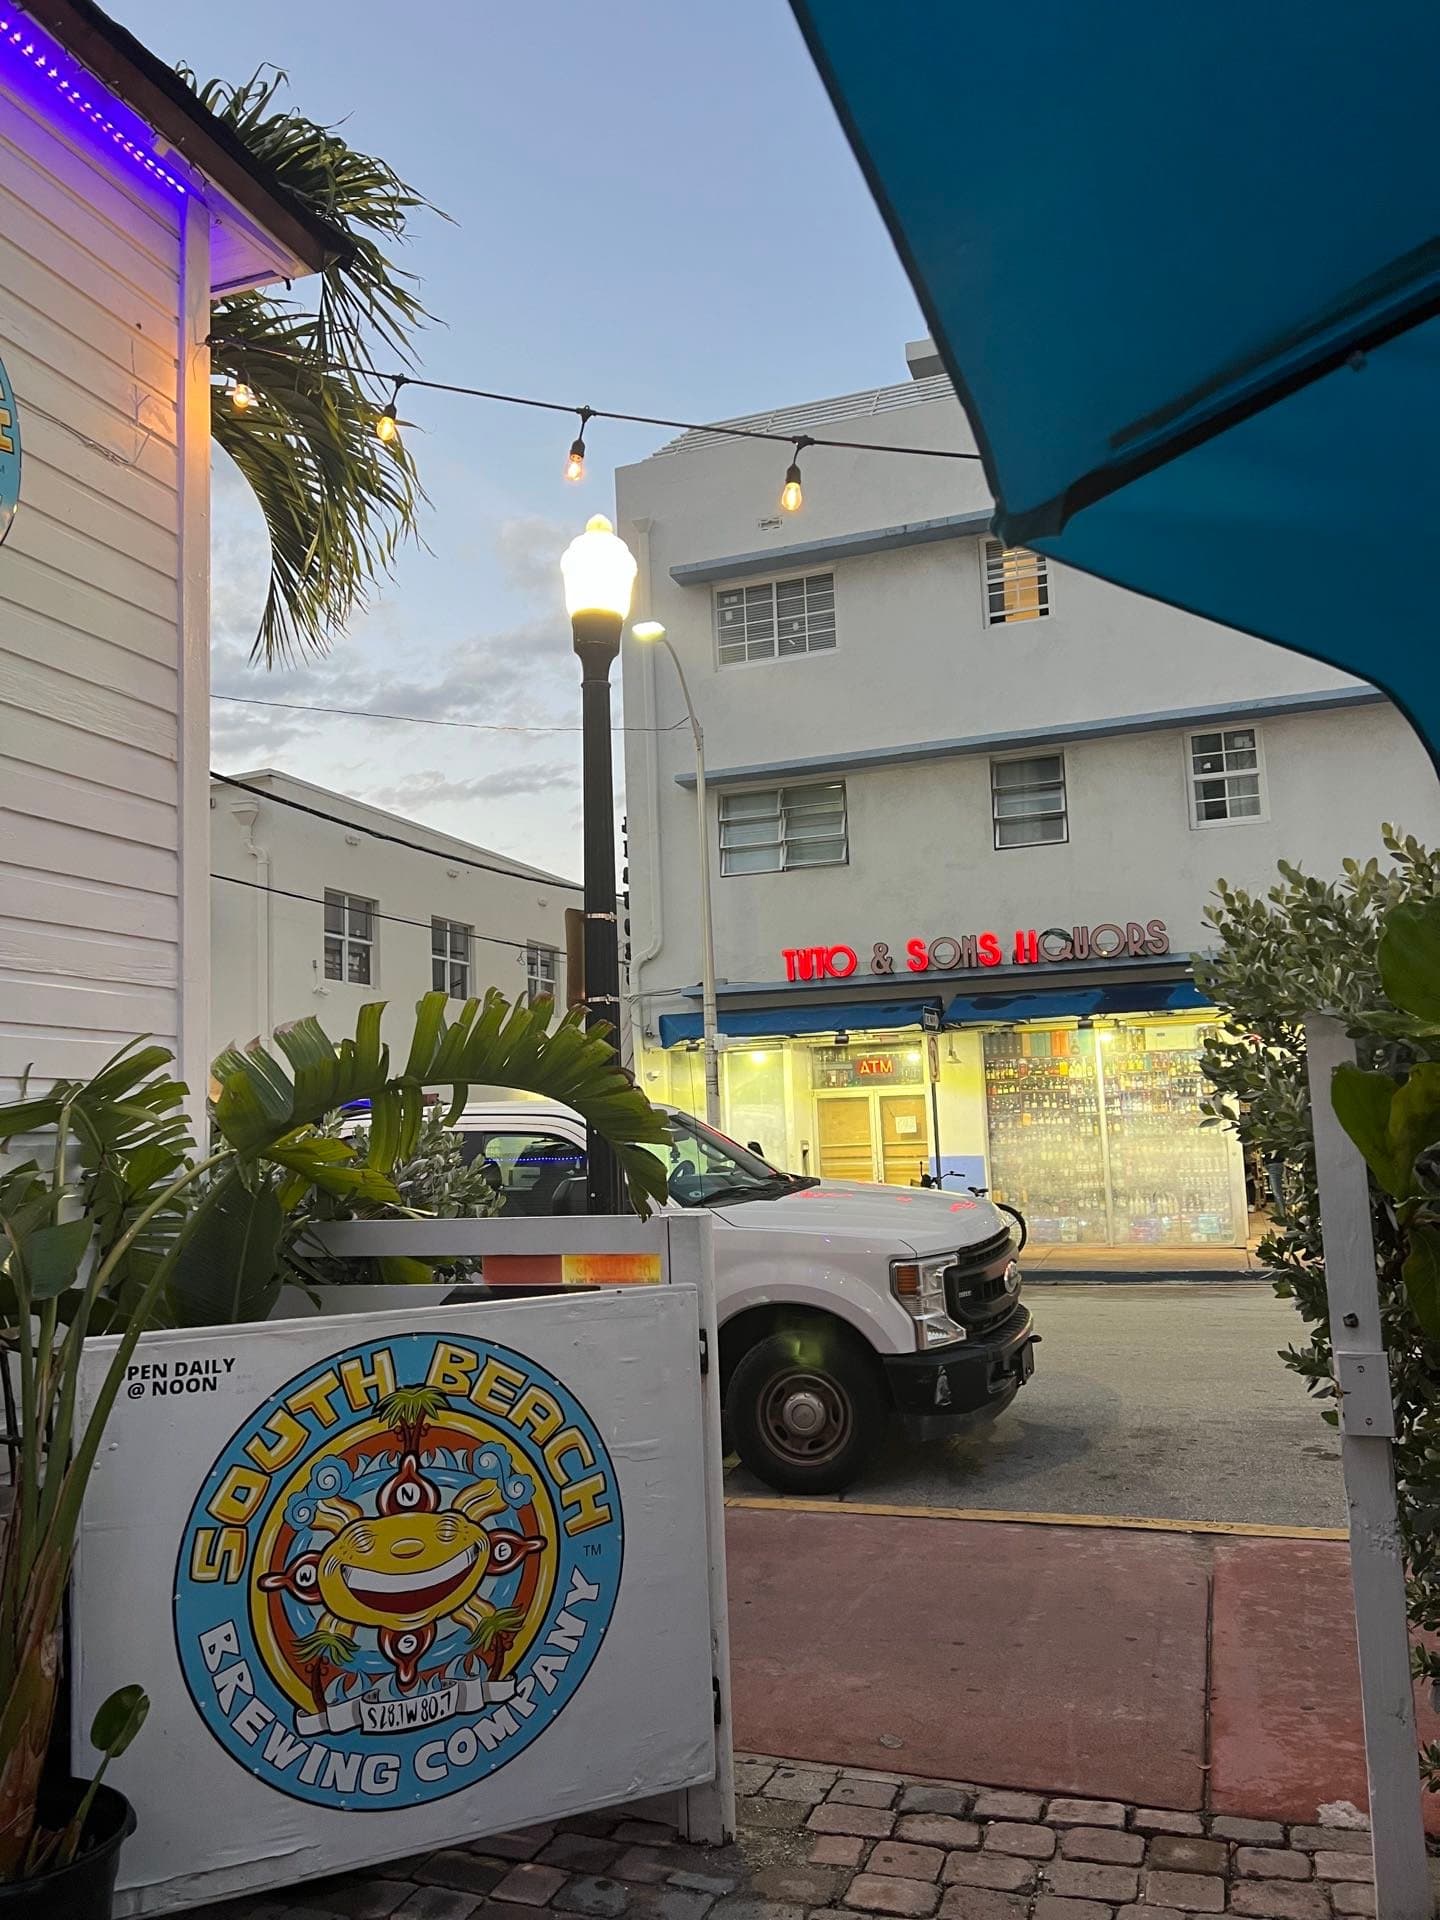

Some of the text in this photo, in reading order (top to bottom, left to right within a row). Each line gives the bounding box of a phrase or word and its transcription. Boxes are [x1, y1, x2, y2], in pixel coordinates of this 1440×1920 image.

[871, 942, 895, 975] &
[906, 932, 1002, 972] SONS
[1013, 919, 1169, 965] LIQUORS
[859, 1060, 893, 1074] ATM
[122, 1357, 236, 1381] PEN DAILY
[152, 1376, 218, 1397] NOON
[189, 1340, 612, 1585] SOUTH BEACH
[198, 1566, 600, 1795] BREWING COMPANY
